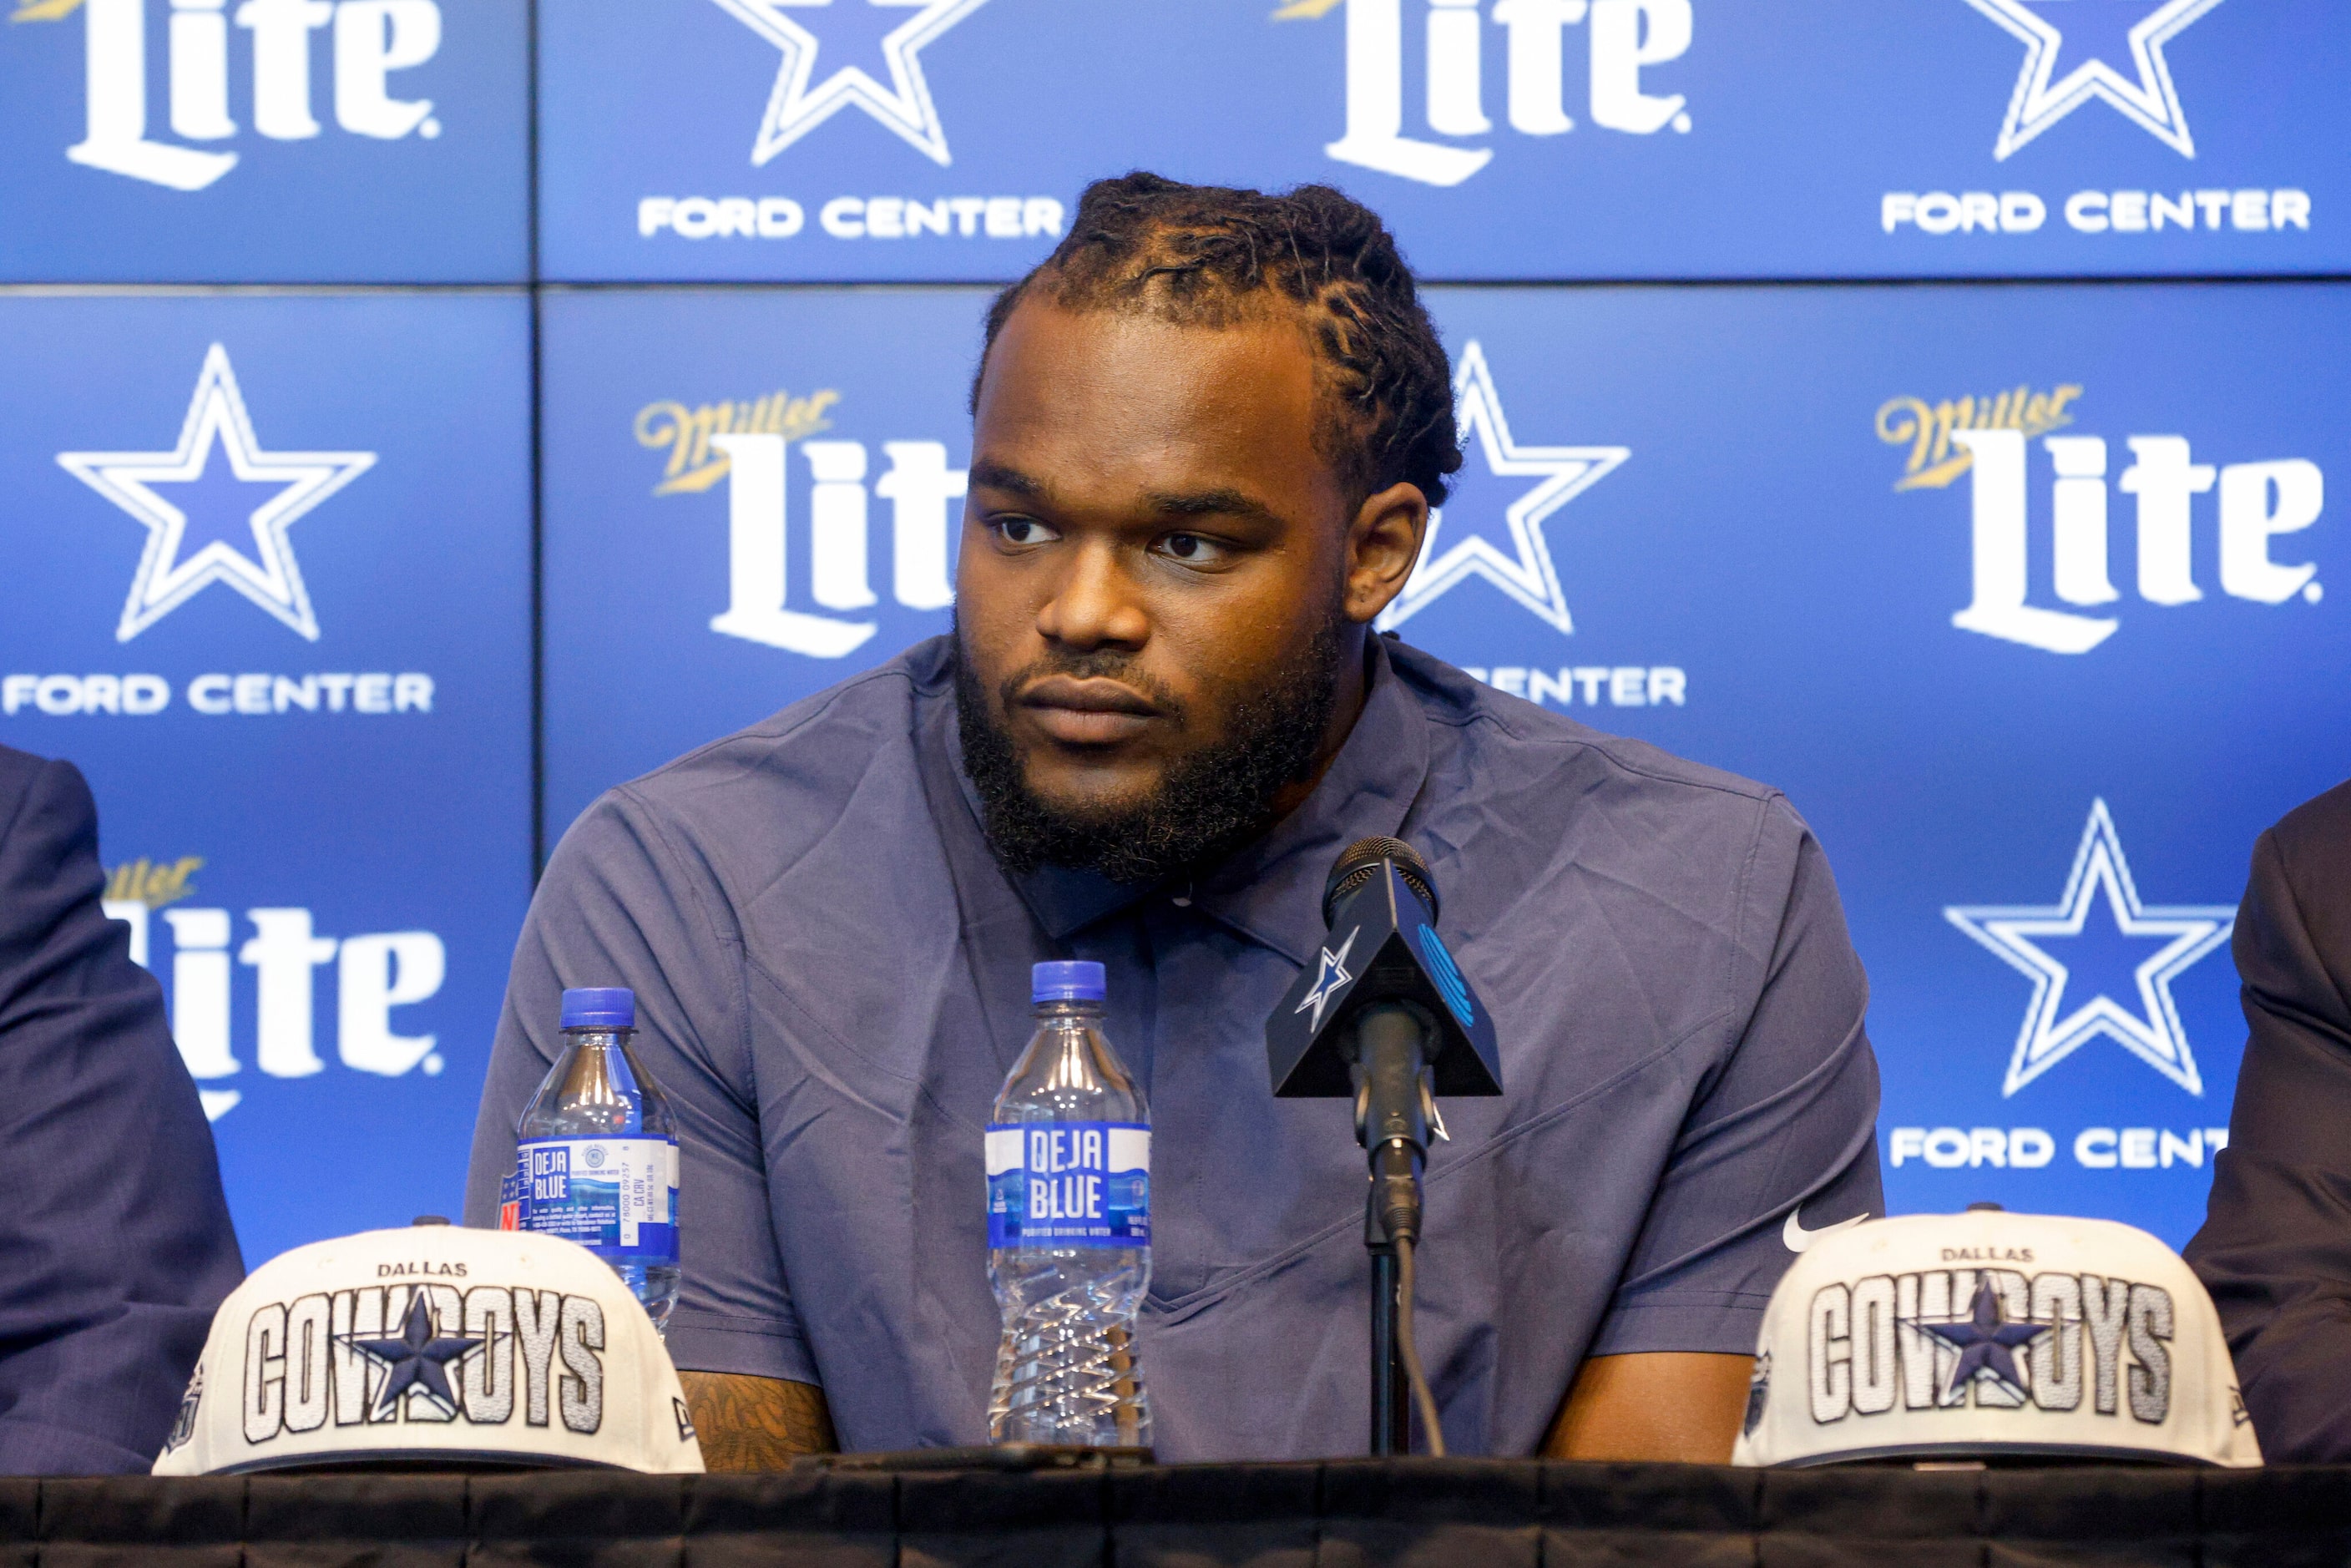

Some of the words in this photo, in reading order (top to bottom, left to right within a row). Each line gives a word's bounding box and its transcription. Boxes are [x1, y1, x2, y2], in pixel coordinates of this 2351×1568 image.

[637, 196, 805, 239] FORD
[819, 196, 1064, 239] CENTER
[1881, 191, 2047, 234] FORD
[2063, 190, 2312, 232] CENTER
[709, 432, 973, 660] Lit
[1, 673, 170, 716] FORD
[187, 673, 435, 715] CENTER
[100, 899, 445, 1123] ite
[534, 1151, 567, 1176] DEJA
[1030, 1129, 1102, 1174] DEJA
[1889, 1127, 2056, 1169] FORD
[2073, 1127, 2229, 1169] CENT
[534, 1175, 567, 1201] BLUE
[621, 1162, 631, 1191] 09257
[633, 1178, 645, 1194] CRV
[1030, 1174, 1102, 1220] BLUE
[621, 1194, 631, 1223] 78000
[633, 1196, 645, 1207] CA
[377, 1261, 468, 1277] DALLAS
[1941, 1247, 2035, 1263] DALLAS
[243, 1282, 607, 1445] COWBOYS
[1808, 1267, 2175, 1424] COWBOYS
